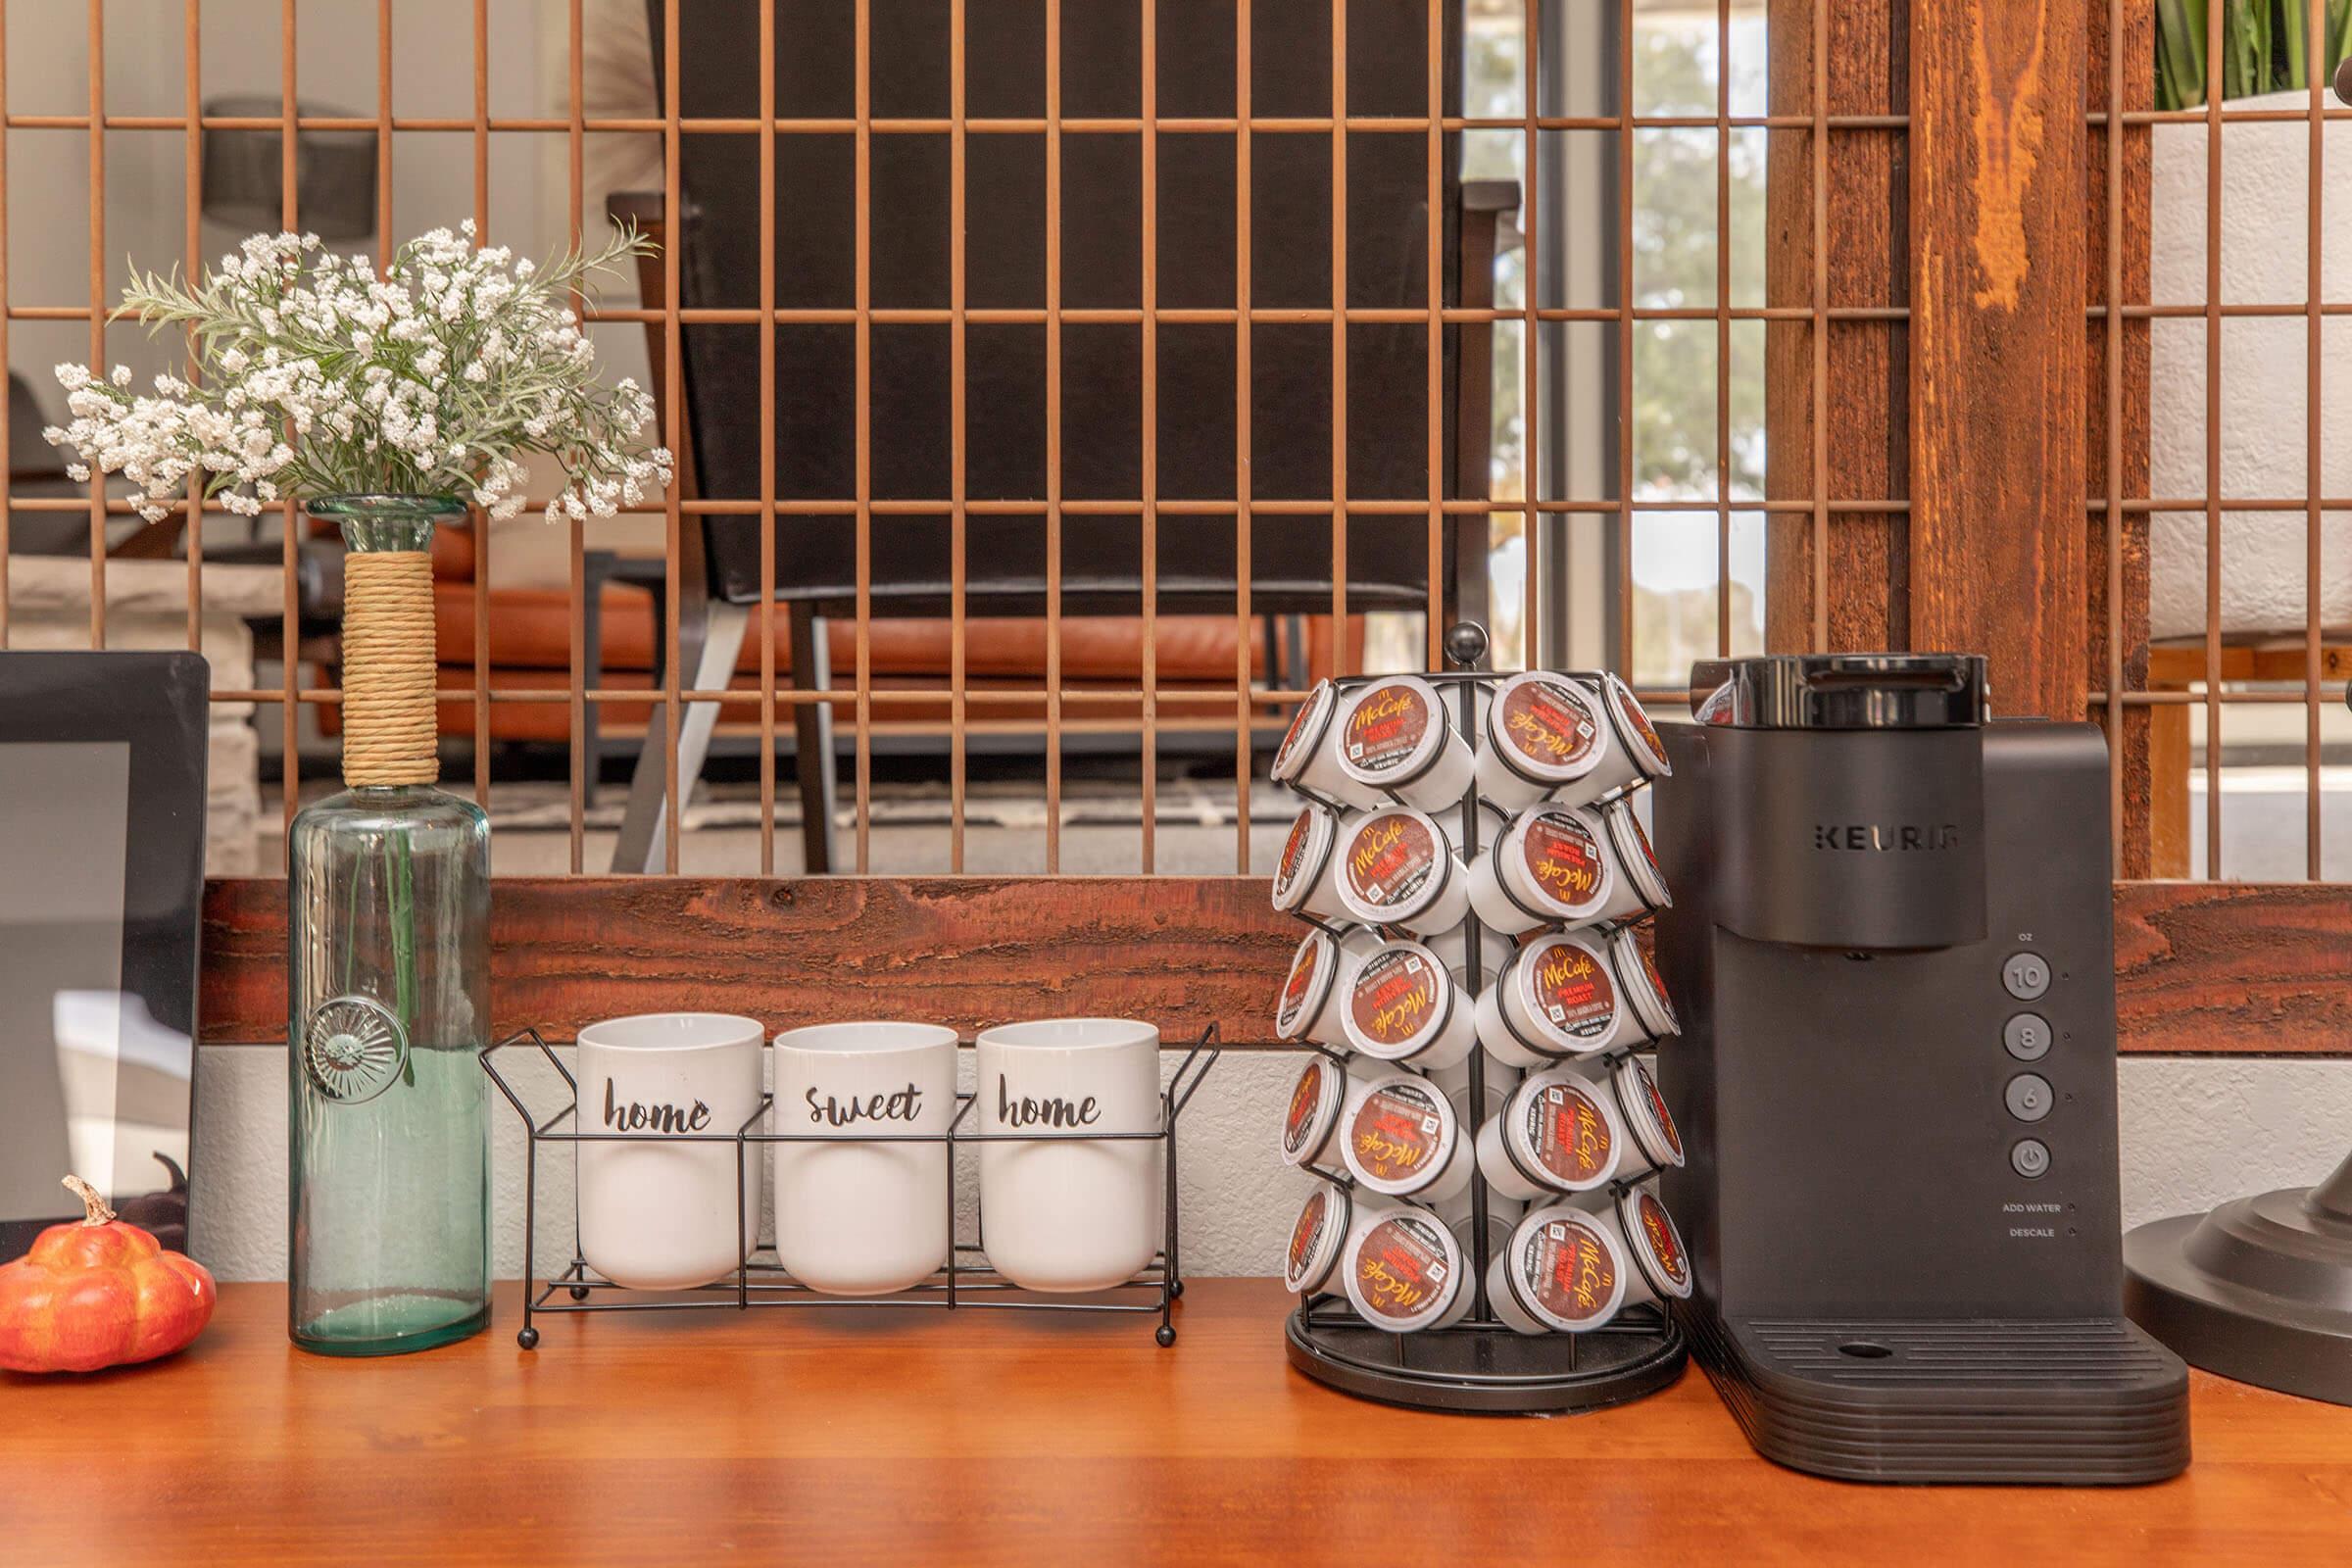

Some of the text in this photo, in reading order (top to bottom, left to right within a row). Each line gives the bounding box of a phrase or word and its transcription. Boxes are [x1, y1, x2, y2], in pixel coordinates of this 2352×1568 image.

[1356, 692, 1413, 730] McCafé
[1511, 710, 1573, 756] McCafé
[1355, 819, 1407, 876] McCafé
[1545, 846, 1586, 866] PREMIUM
[1551, 841, 1581, 855] ROAST
[1537, 858, 1592, 892] McCafé
[1374, 975, 1403, 998] ROAST
[1544, 955, 1592, 990] McCafé
[2012, 966, 2040, 988] 10
[1371, 980, 1412, 1010] PREMIUM
[1558, 983, 1594, 999] PREMIUM
[1566, 992, 1592, 1004] ROAST
[1374, 986, 1426, 1038] McCafé
[2021, 1027, 2036, 1048] 8
[604, 1077, 711, 1134] home
[806, 1082, 923, 1127] sweet
[999, 1073, 1102, 1128] home
[2023, 1088, 2037, 1108] 6
[1564, 1107, 1574, 1154] PREMIUM
[1575, 1102, 1597, 1170] McCafé
[1360, 1132, 1420, 1166] McCafé
[2002, 1203, 2062, 1213] ADD WATER
[2009, 1228, 2055, 1238] DESCALE
[1362, 1258, 1422, 1307] McCafé
[1555, 1248, 1567, 1283] ROAST
[1563, 1243, 1576, 1293] PREMIUM
[1574, 1239, 1601, 1308] McCafé
